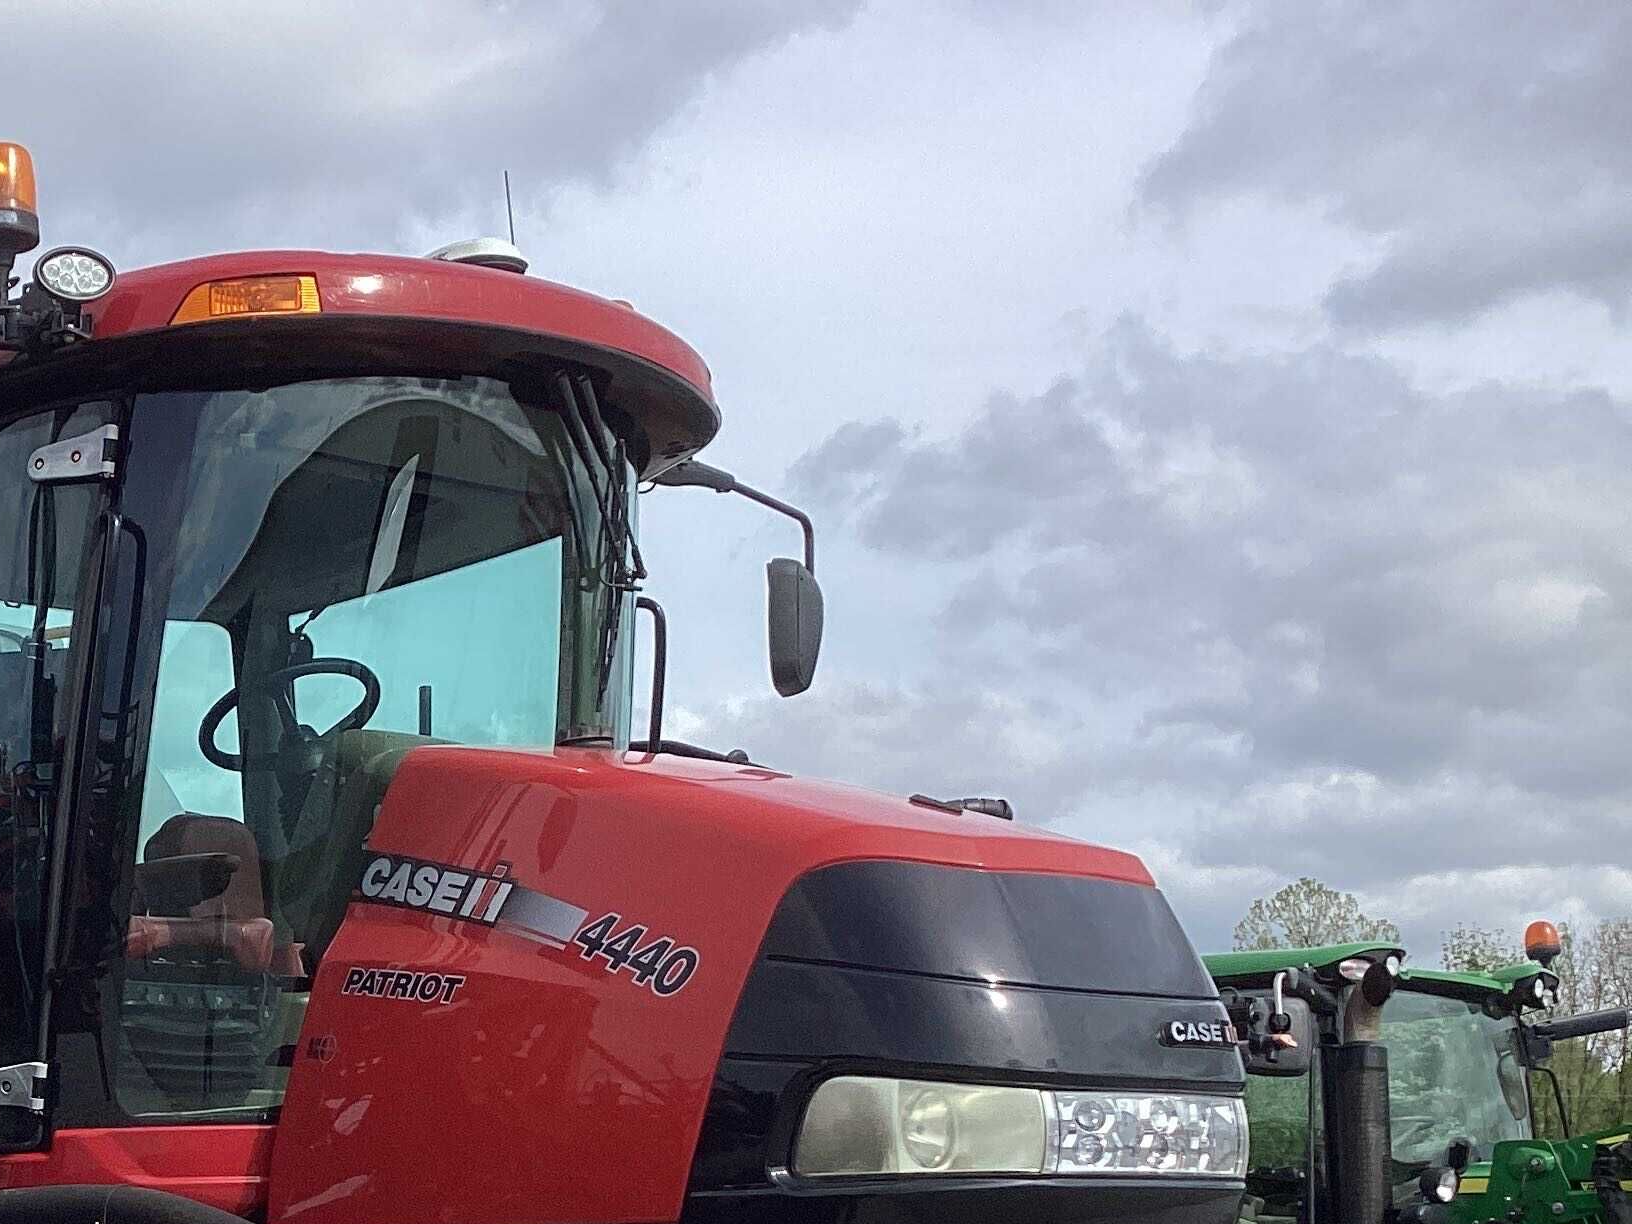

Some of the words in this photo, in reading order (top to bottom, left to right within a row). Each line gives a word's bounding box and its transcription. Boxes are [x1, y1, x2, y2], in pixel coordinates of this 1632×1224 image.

[361, 857, 470, 913] CASE
[574, 911, 700, 997] 4440
[341, 966, 465, 1005] PATRIOT
[1171, 1021, 1223, 1042] CASE
